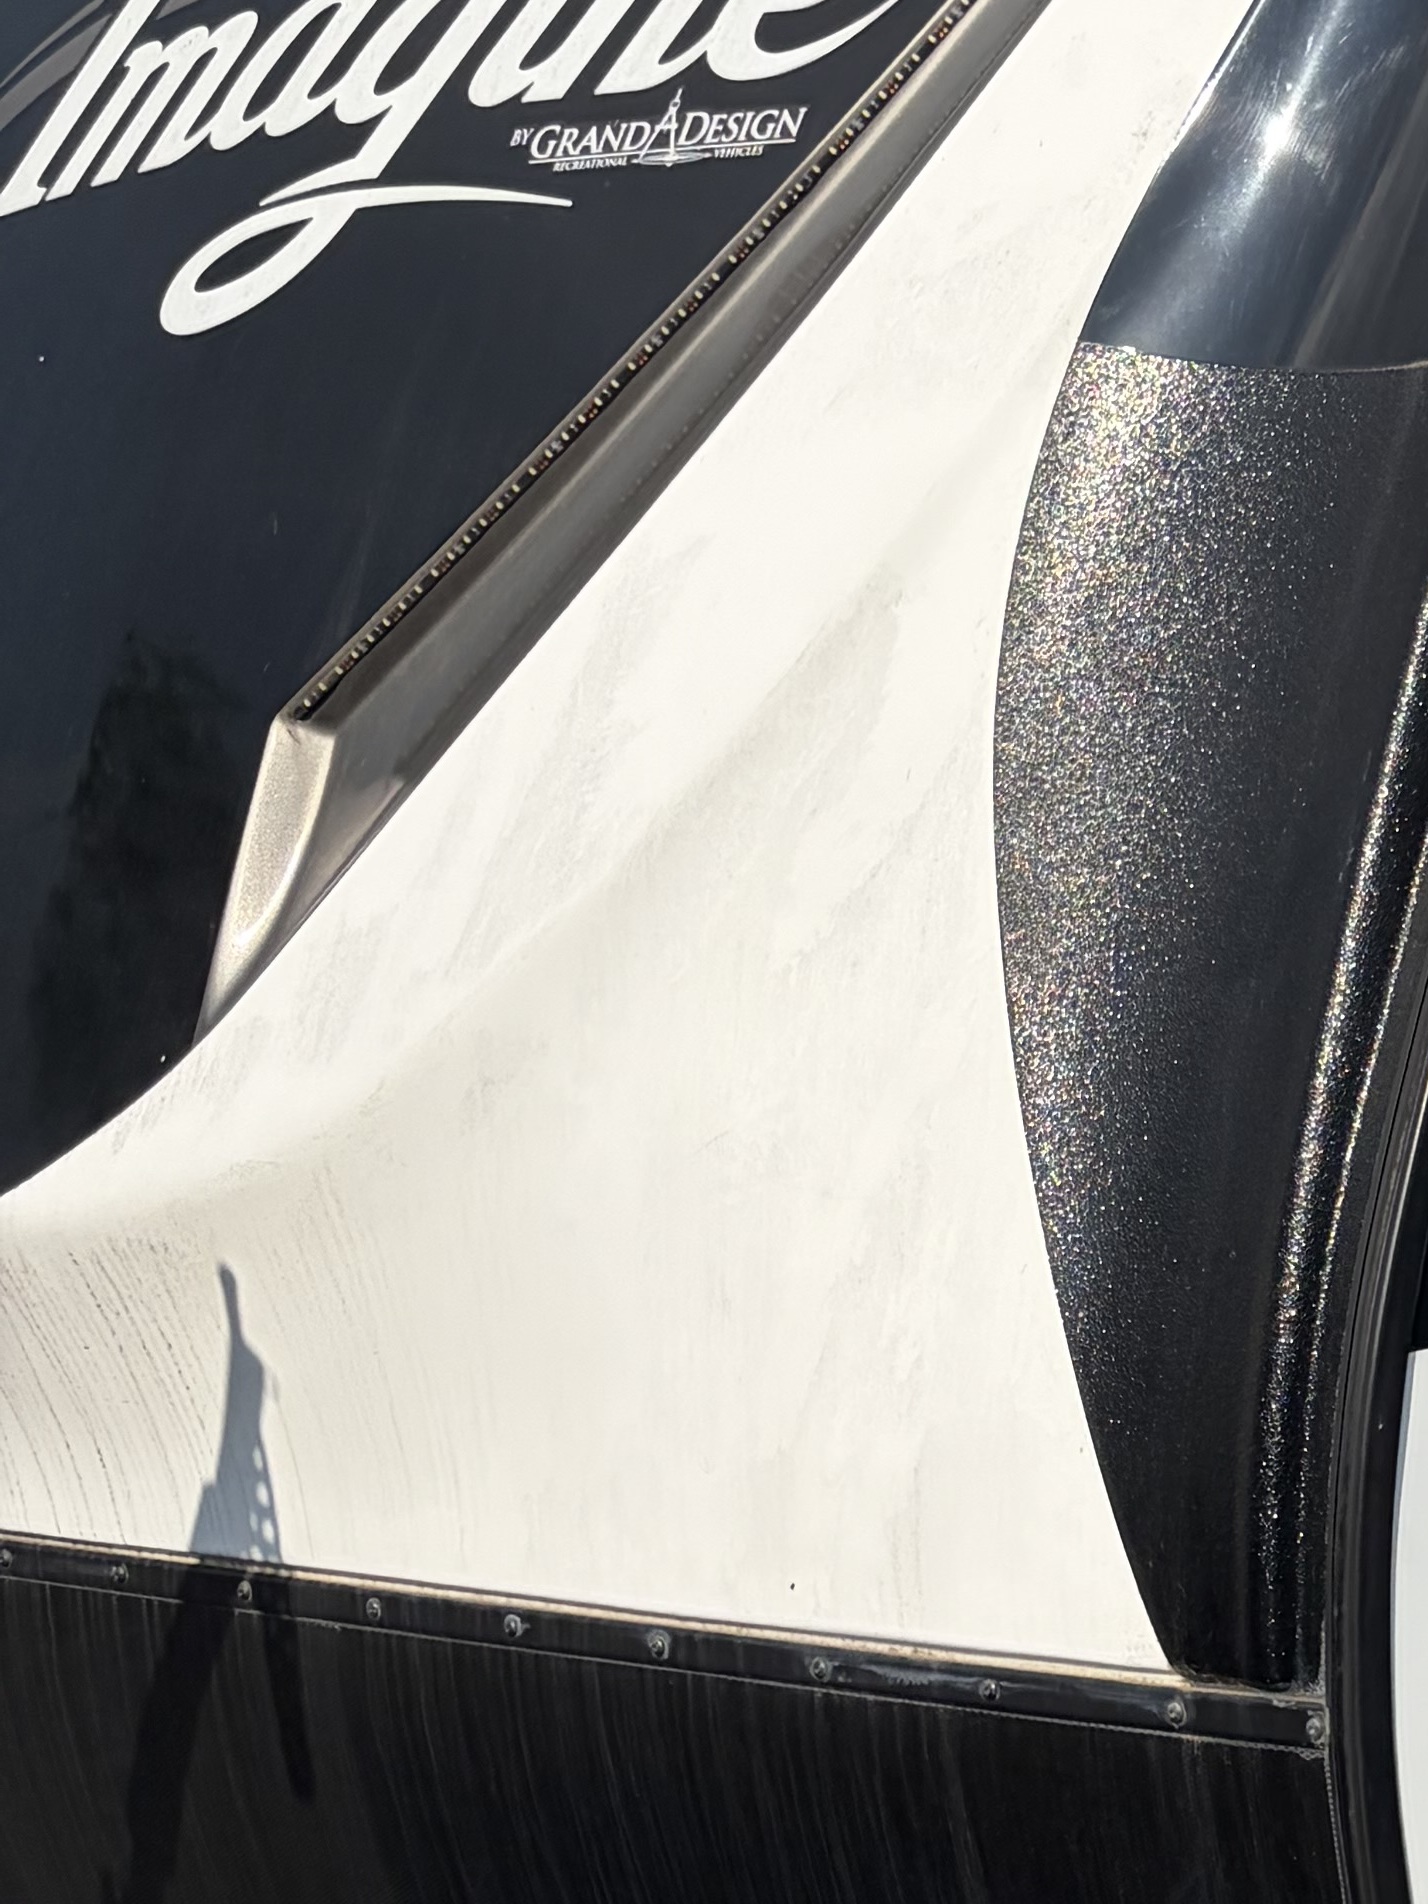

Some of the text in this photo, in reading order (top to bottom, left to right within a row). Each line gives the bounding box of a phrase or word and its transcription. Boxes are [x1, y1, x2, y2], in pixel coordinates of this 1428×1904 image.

[509, 128, 534, 147] BY
[676, 106, 810, 147] DESIGN
[552, 145, 765, 173] RECREATIONAL VEHICLES
